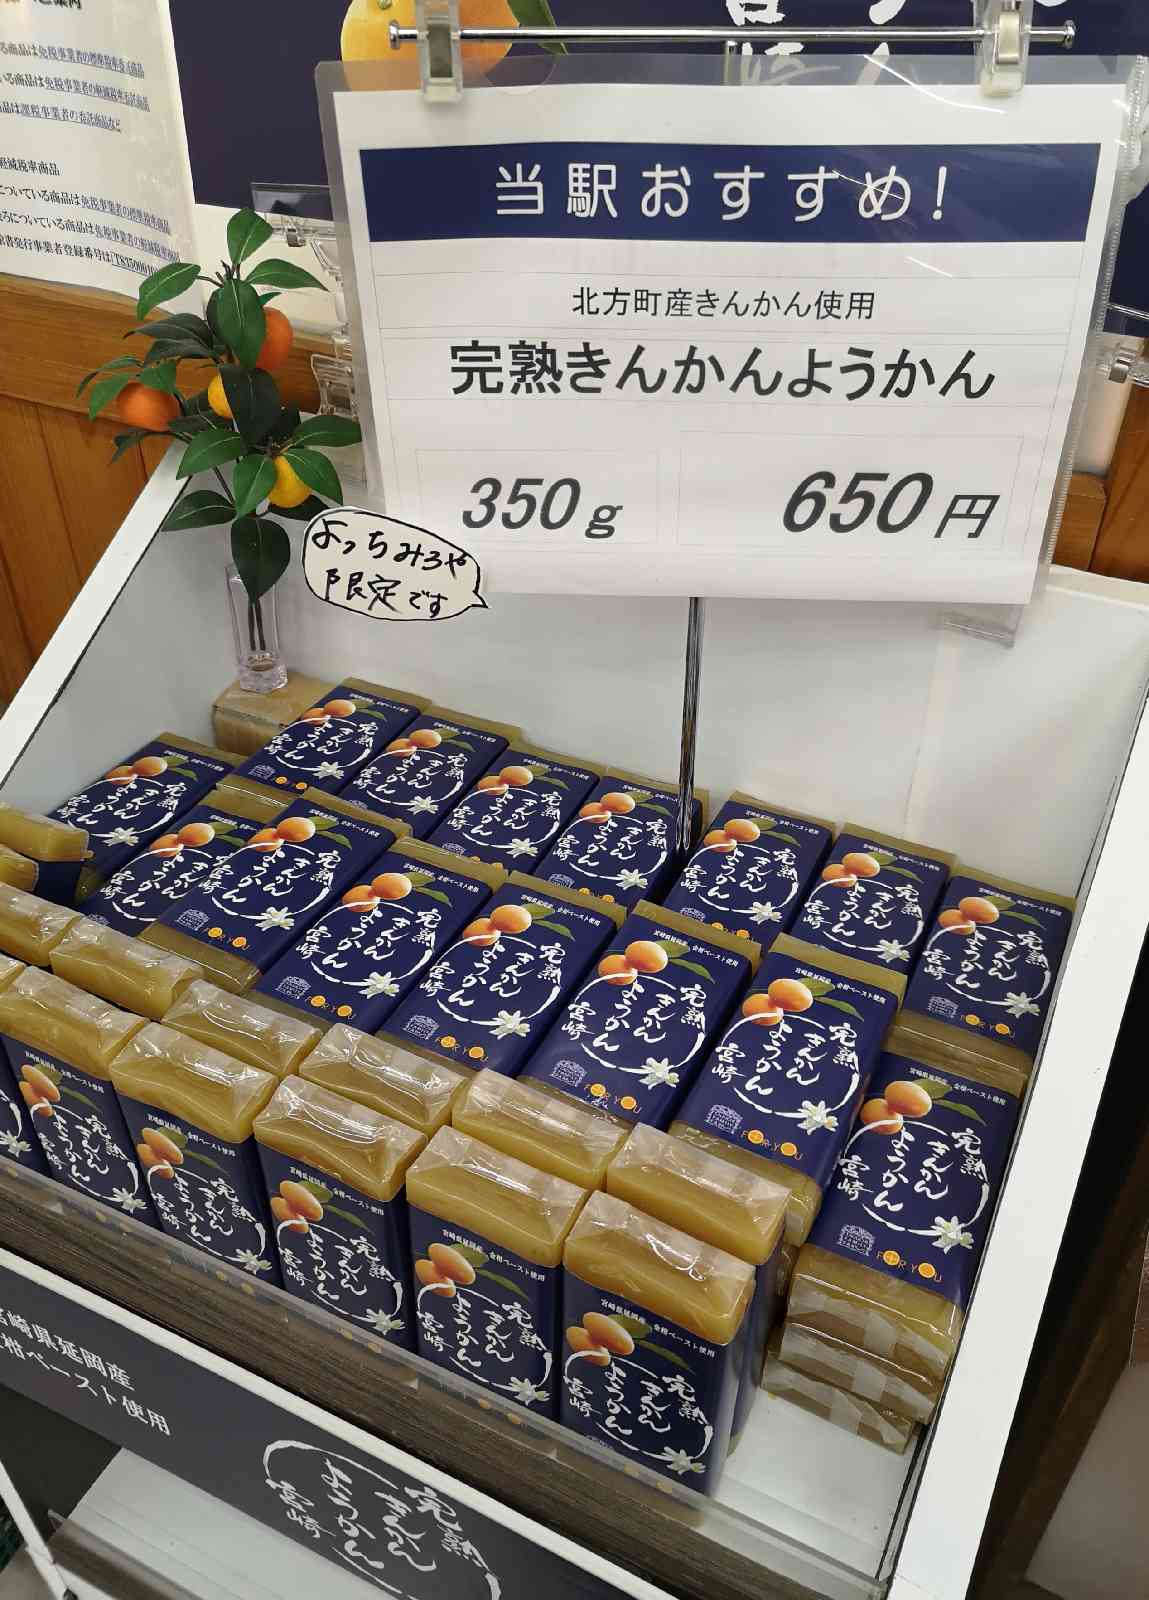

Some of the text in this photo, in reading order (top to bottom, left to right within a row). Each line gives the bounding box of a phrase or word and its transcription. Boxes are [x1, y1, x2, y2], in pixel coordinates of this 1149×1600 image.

[572, 286, 876, 321] 北方町産きんかん使用
[450, 339, 996, 400] 完熟きんかんようかん
[462, 477, 582, 530] 350
[782, 472, 1000, 540] 650 円
[312, 519, 467, 579] よっちみろや
[325, 568, 448, 618] 限定です
[0, 1333, 170, 1435] 柑ペースト使用
